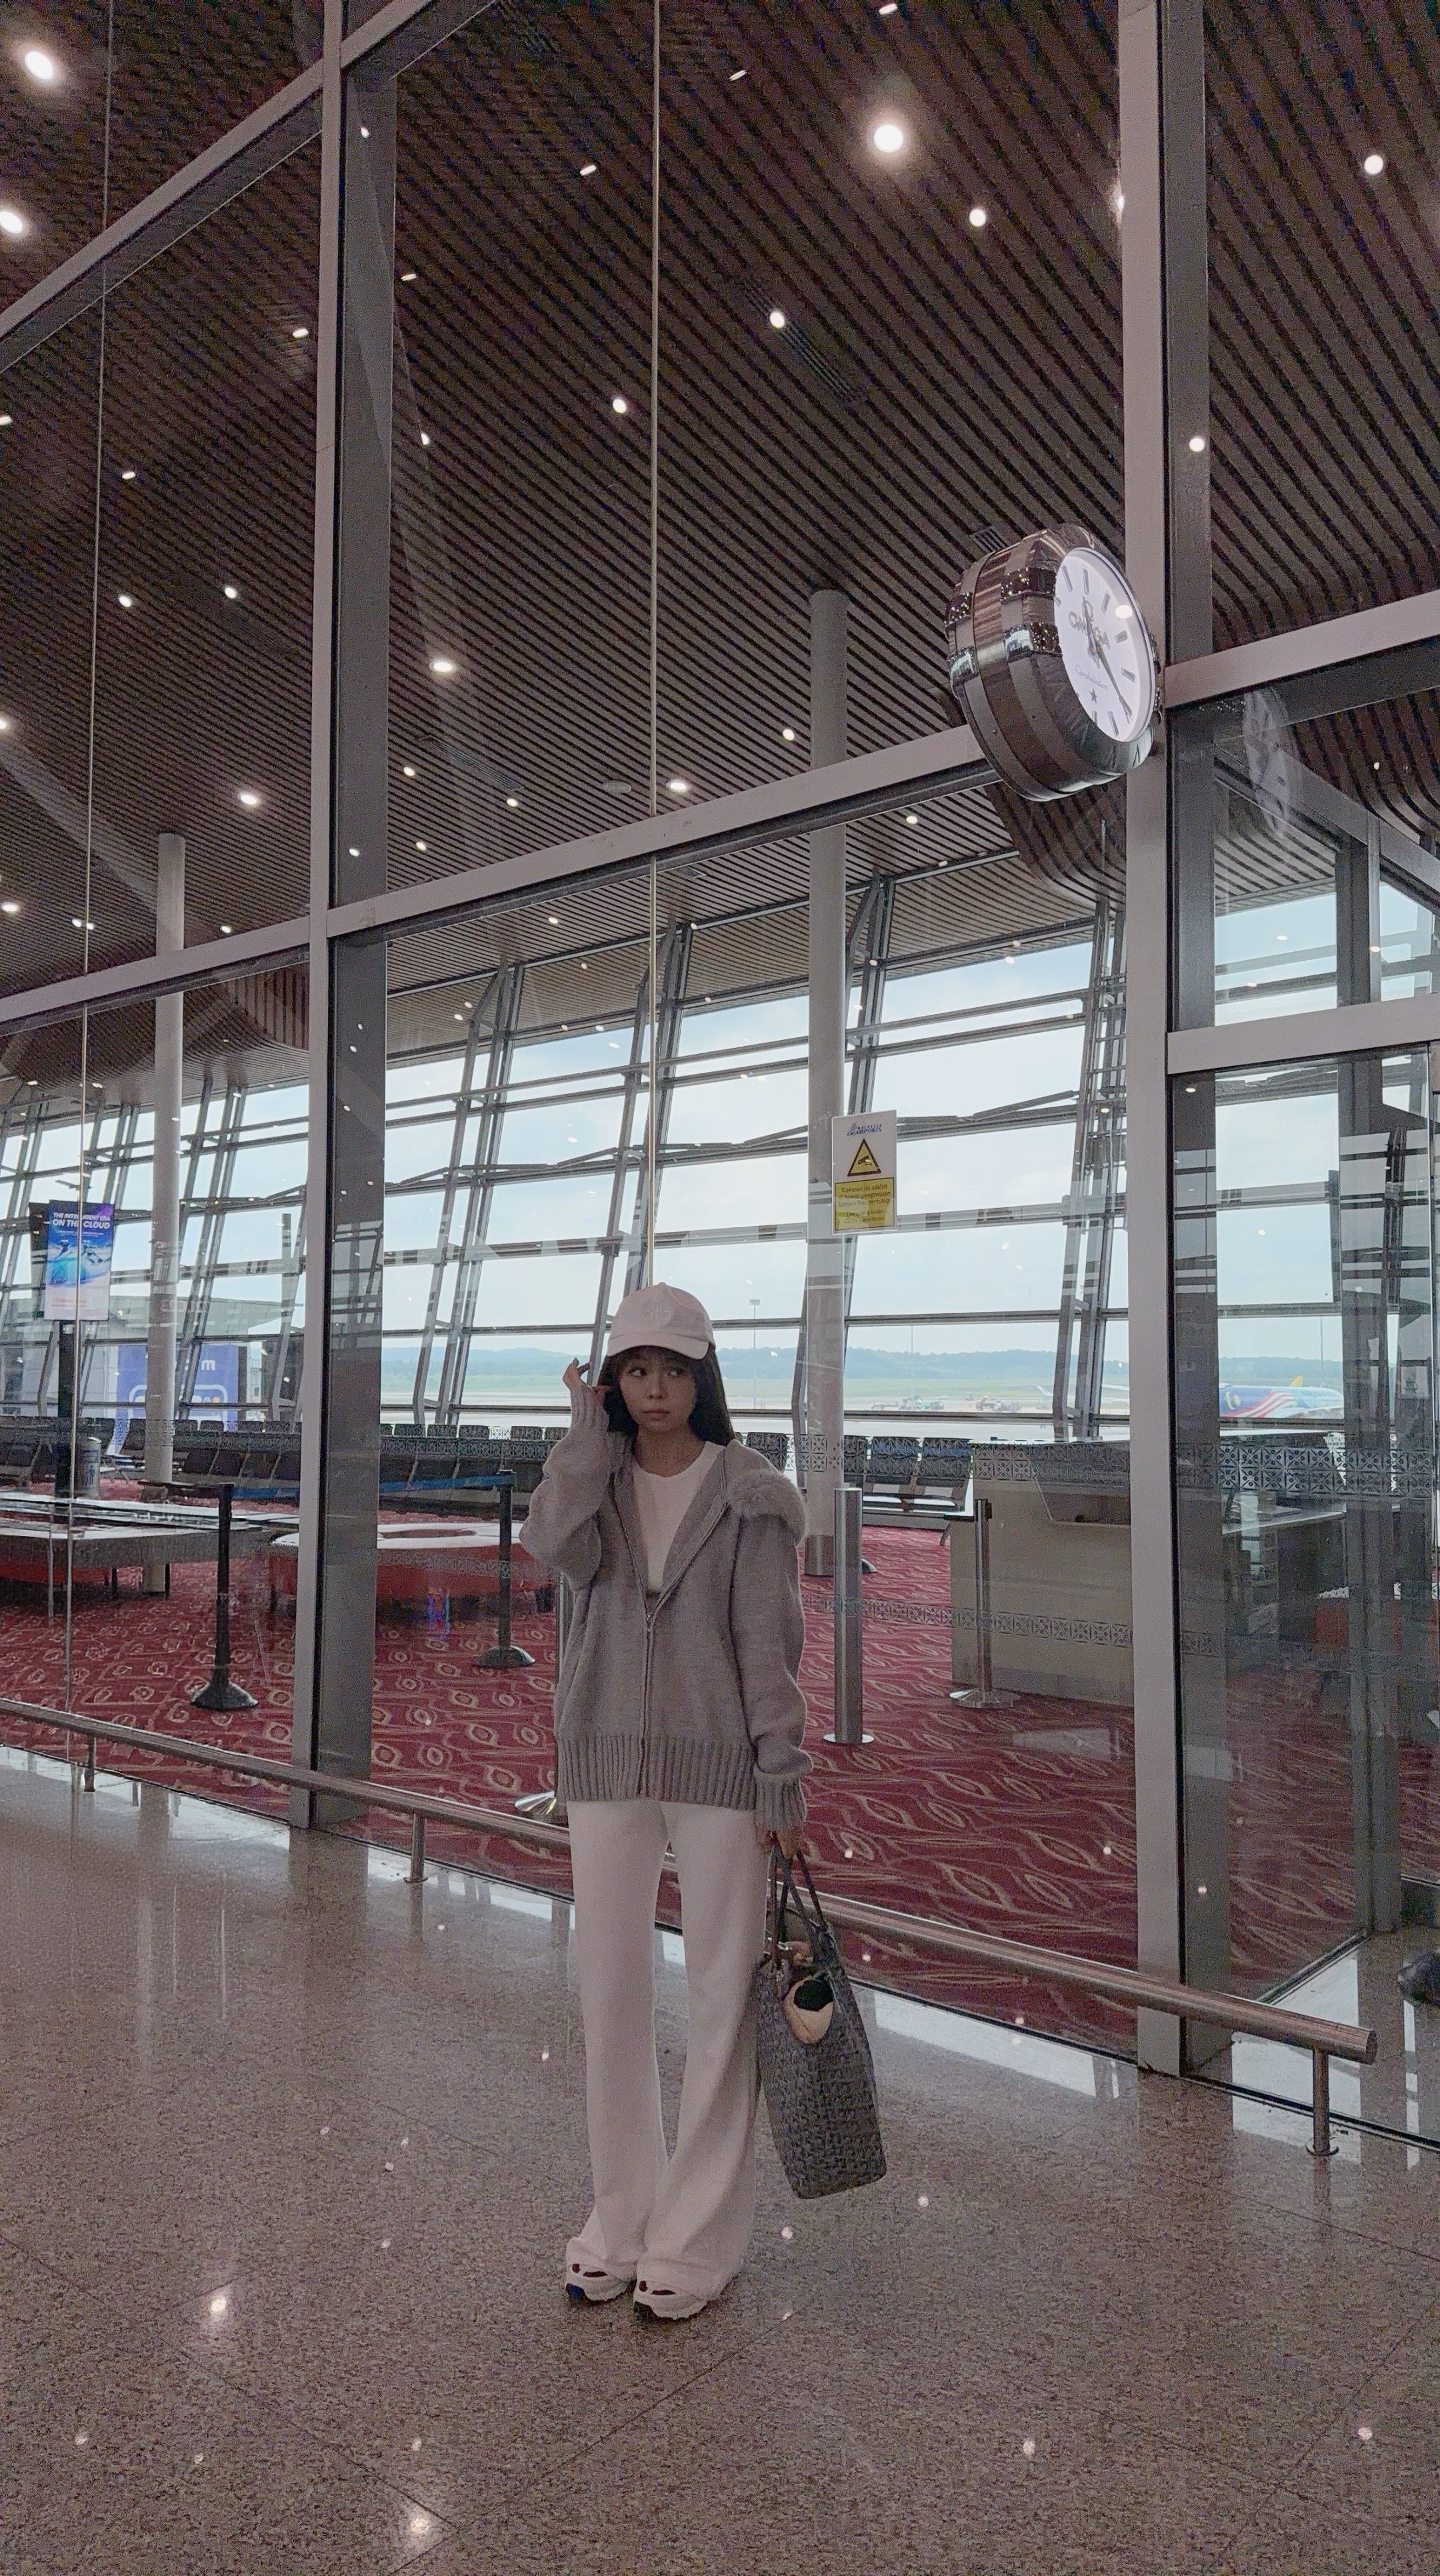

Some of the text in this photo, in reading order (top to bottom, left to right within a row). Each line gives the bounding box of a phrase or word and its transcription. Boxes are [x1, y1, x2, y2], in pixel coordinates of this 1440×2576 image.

[1069, 611, 1111, 650] OMGA
[53, 1219, 111, 1229] ON TH CLOUD
